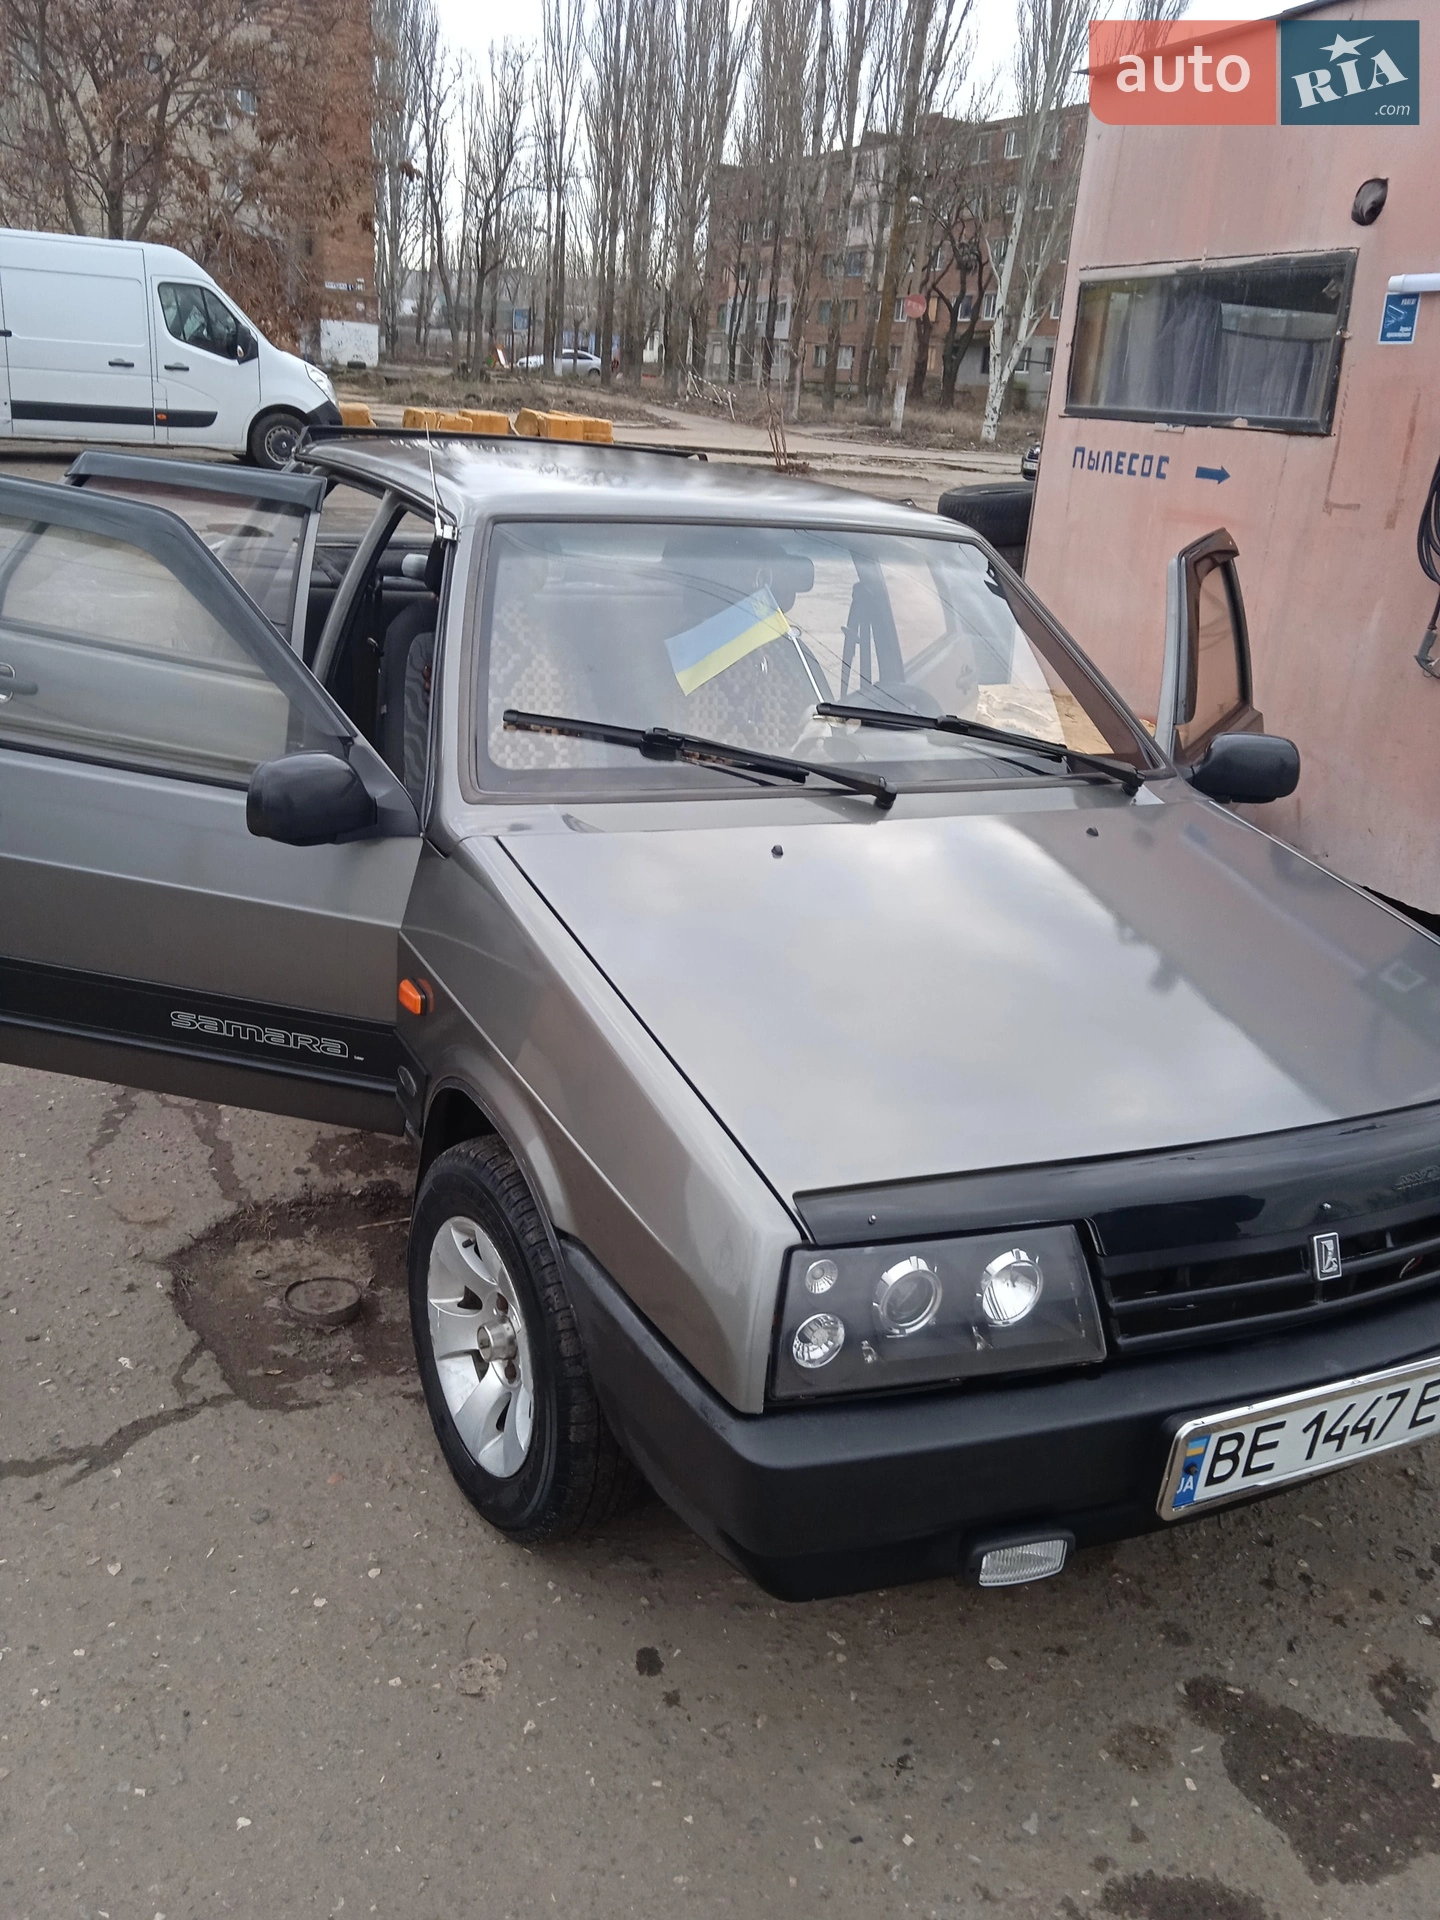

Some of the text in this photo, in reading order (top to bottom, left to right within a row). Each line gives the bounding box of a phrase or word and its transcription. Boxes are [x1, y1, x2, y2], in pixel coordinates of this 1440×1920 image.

[1072, 446, 1170, 480] ПЫЛЕСОС
[1204, 1420, 1287, 1487] BE
[1302, 1388, 1411, 1461] 1447
